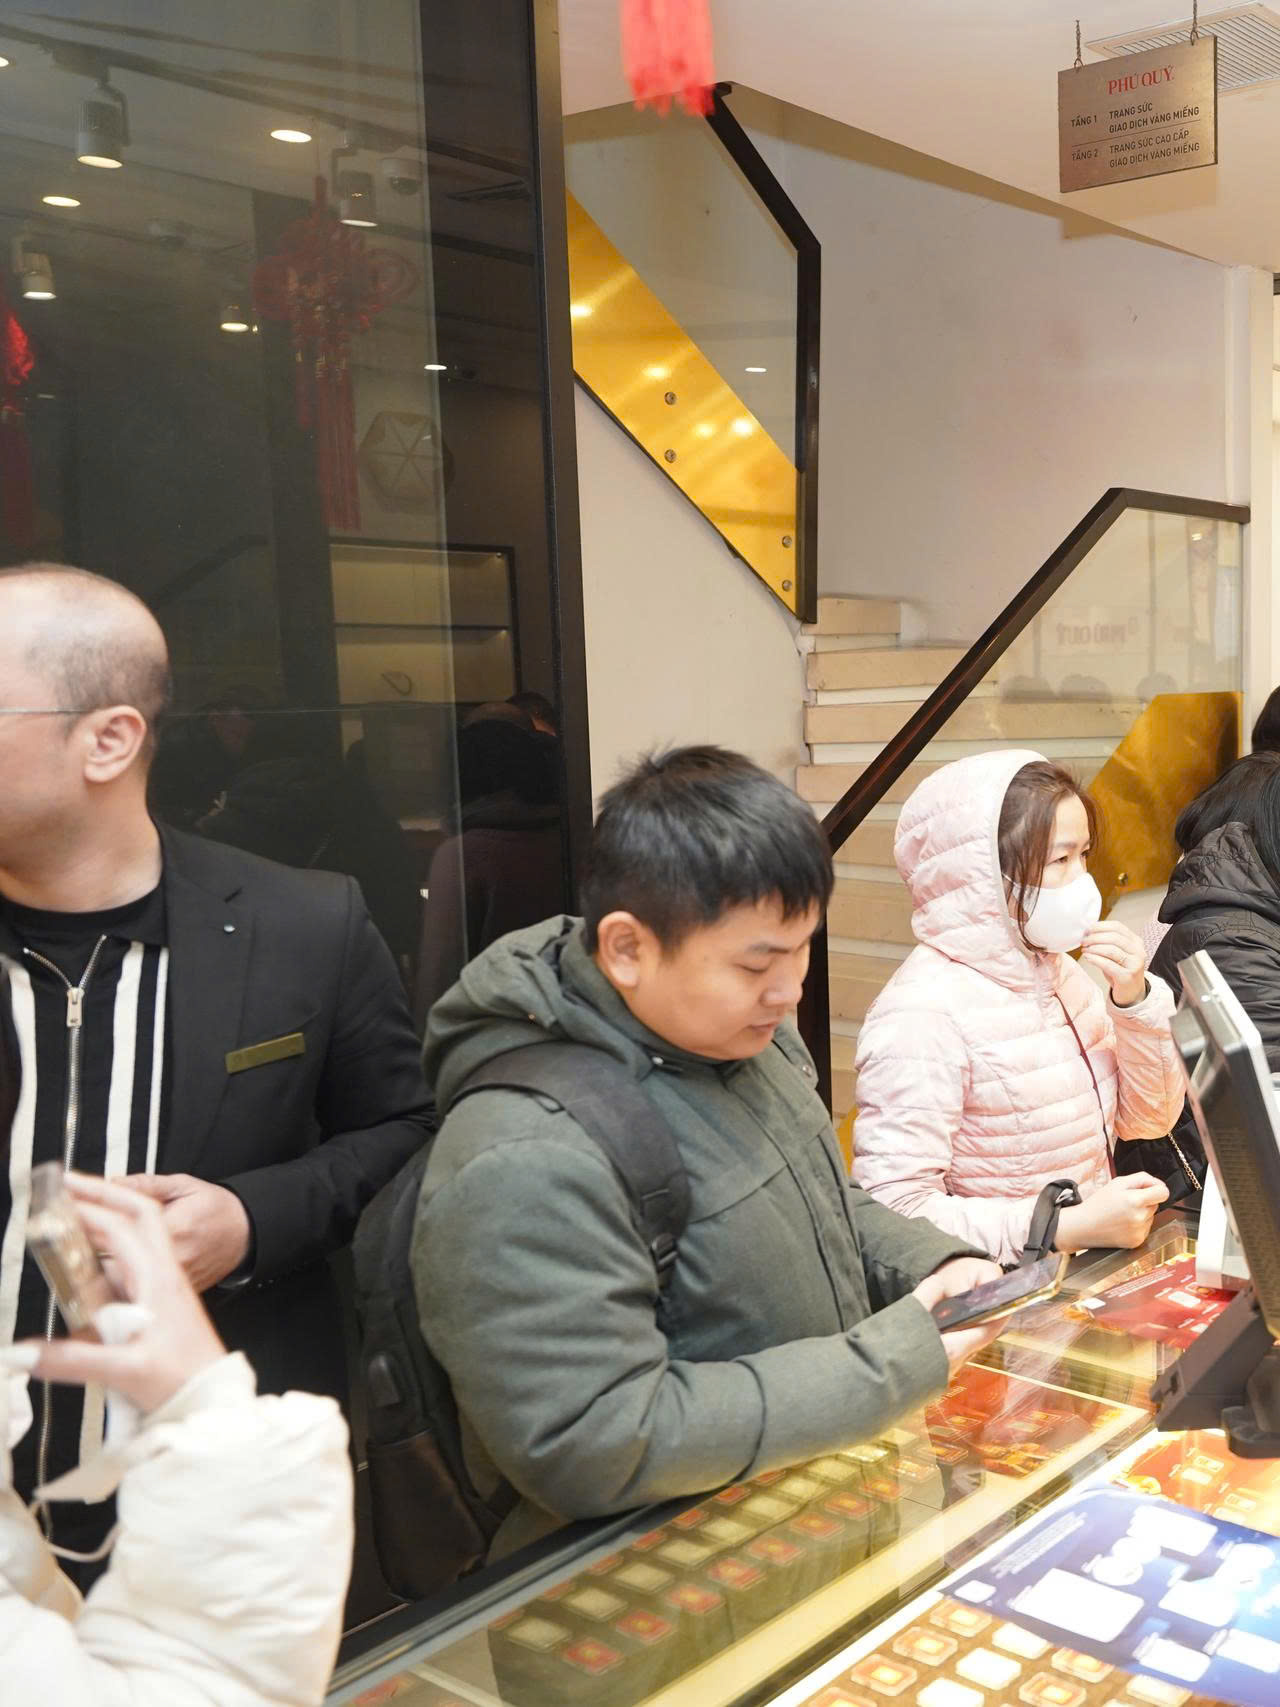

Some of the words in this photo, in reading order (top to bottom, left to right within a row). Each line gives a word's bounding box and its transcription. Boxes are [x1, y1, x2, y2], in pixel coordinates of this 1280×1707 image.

[1109, 106, 1136, 120] TRANG
[1109, 122, 1128, 134] GIAO
[1109, 141, 1136, 154] TRANG
[1155, 134, 1171, 145] CAO
[1110, 157, 1128, 168] GIAO
